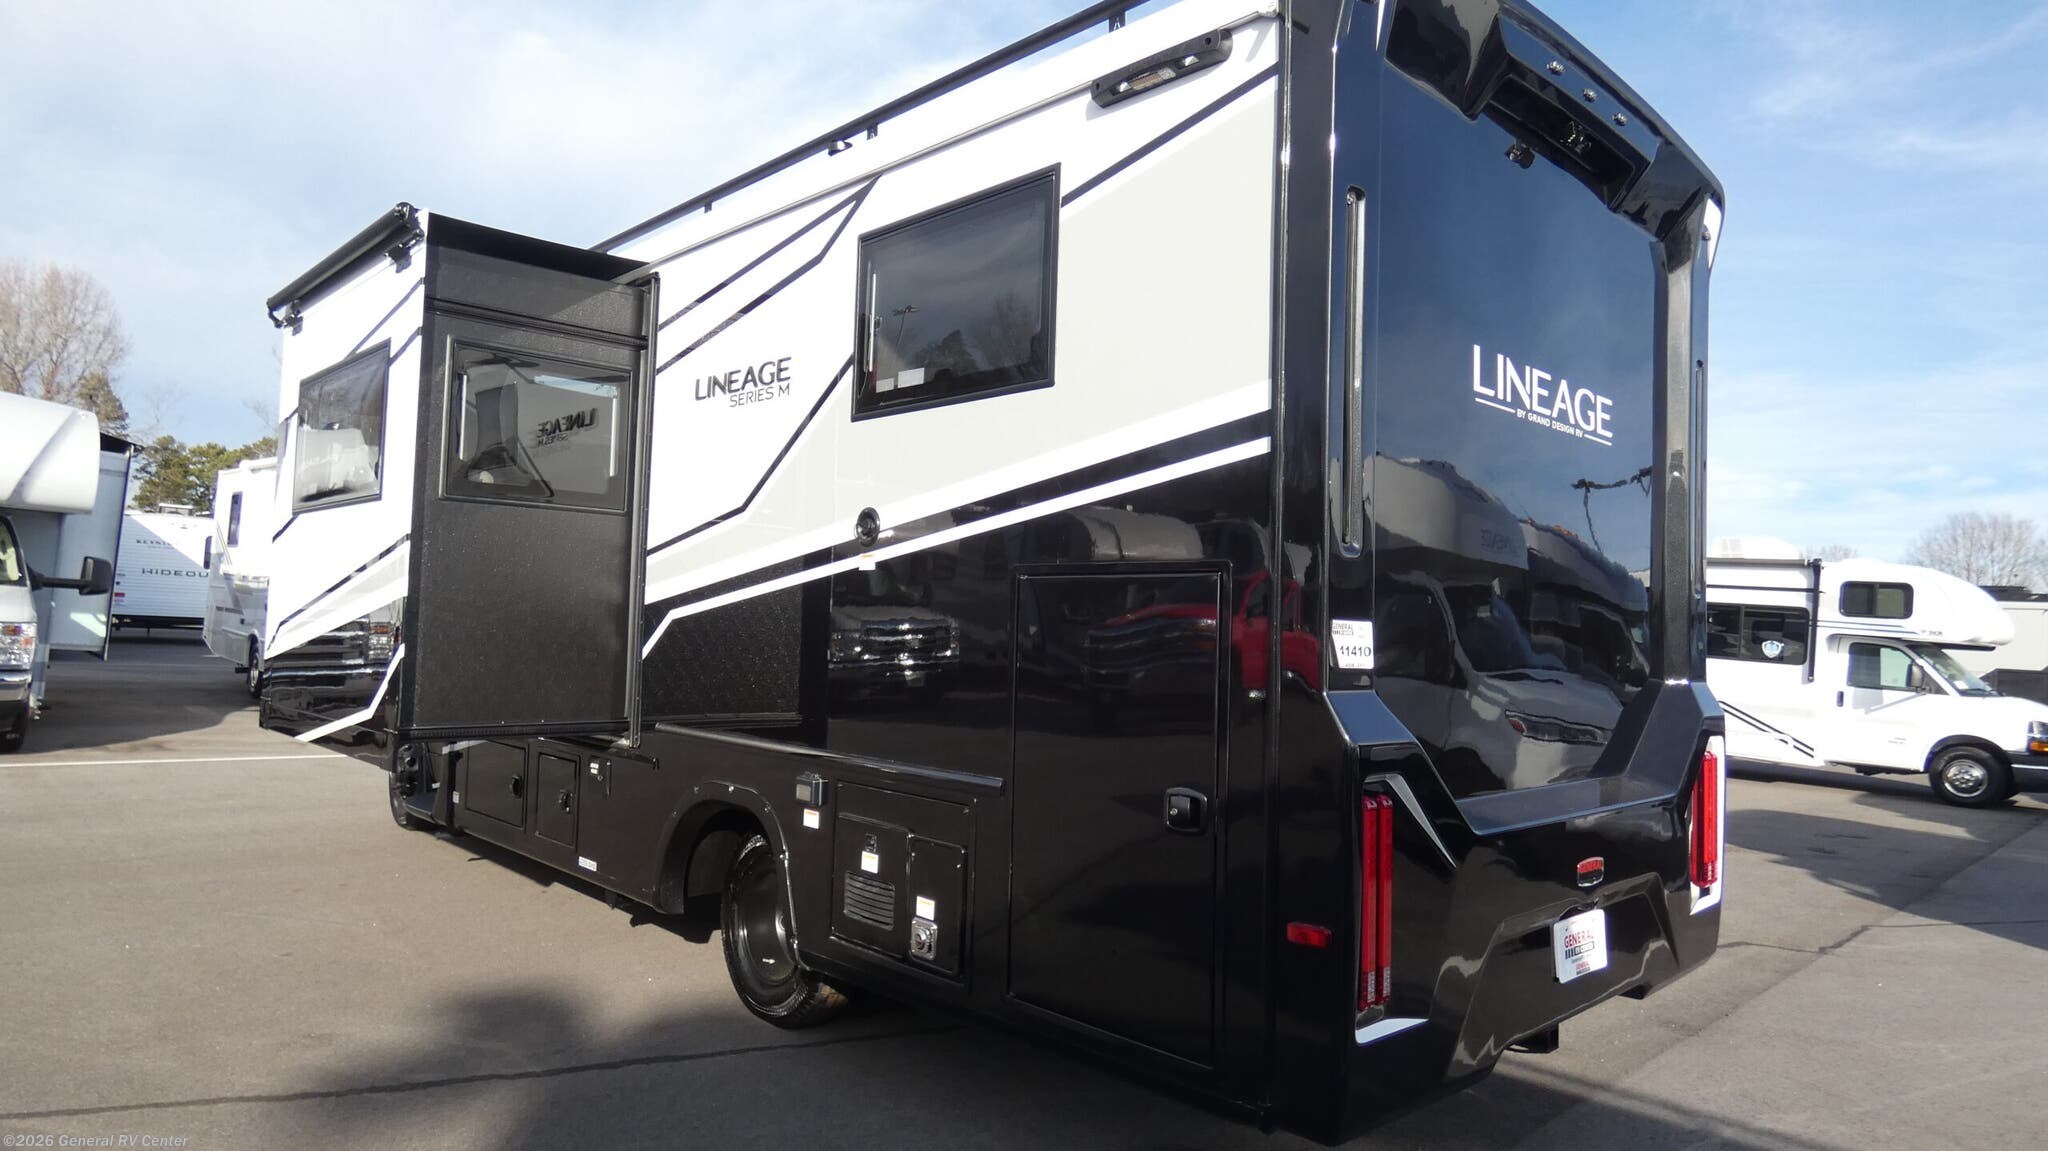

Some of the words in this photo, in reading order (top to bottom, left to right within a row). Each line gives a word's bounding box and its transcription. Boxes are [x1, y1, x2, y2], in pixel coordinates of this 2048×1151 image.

[695, 356, 792, 401] LINEAGE
[1473, 344, 1613, 438] LINEAGE
[729, 386, 774, 408] SERIES
[778, 383, 790, 398] M
[1516, 408, 1527, 419] BY
[1528, 412, 1551, 427] GRAND
[1552, 420, 1575, 435] DESIGN
[1575, 427, 1584, 438] RV
[142, 567, 209, 578] HIDEOU
[1340, 645, 1372, 657] 11410
